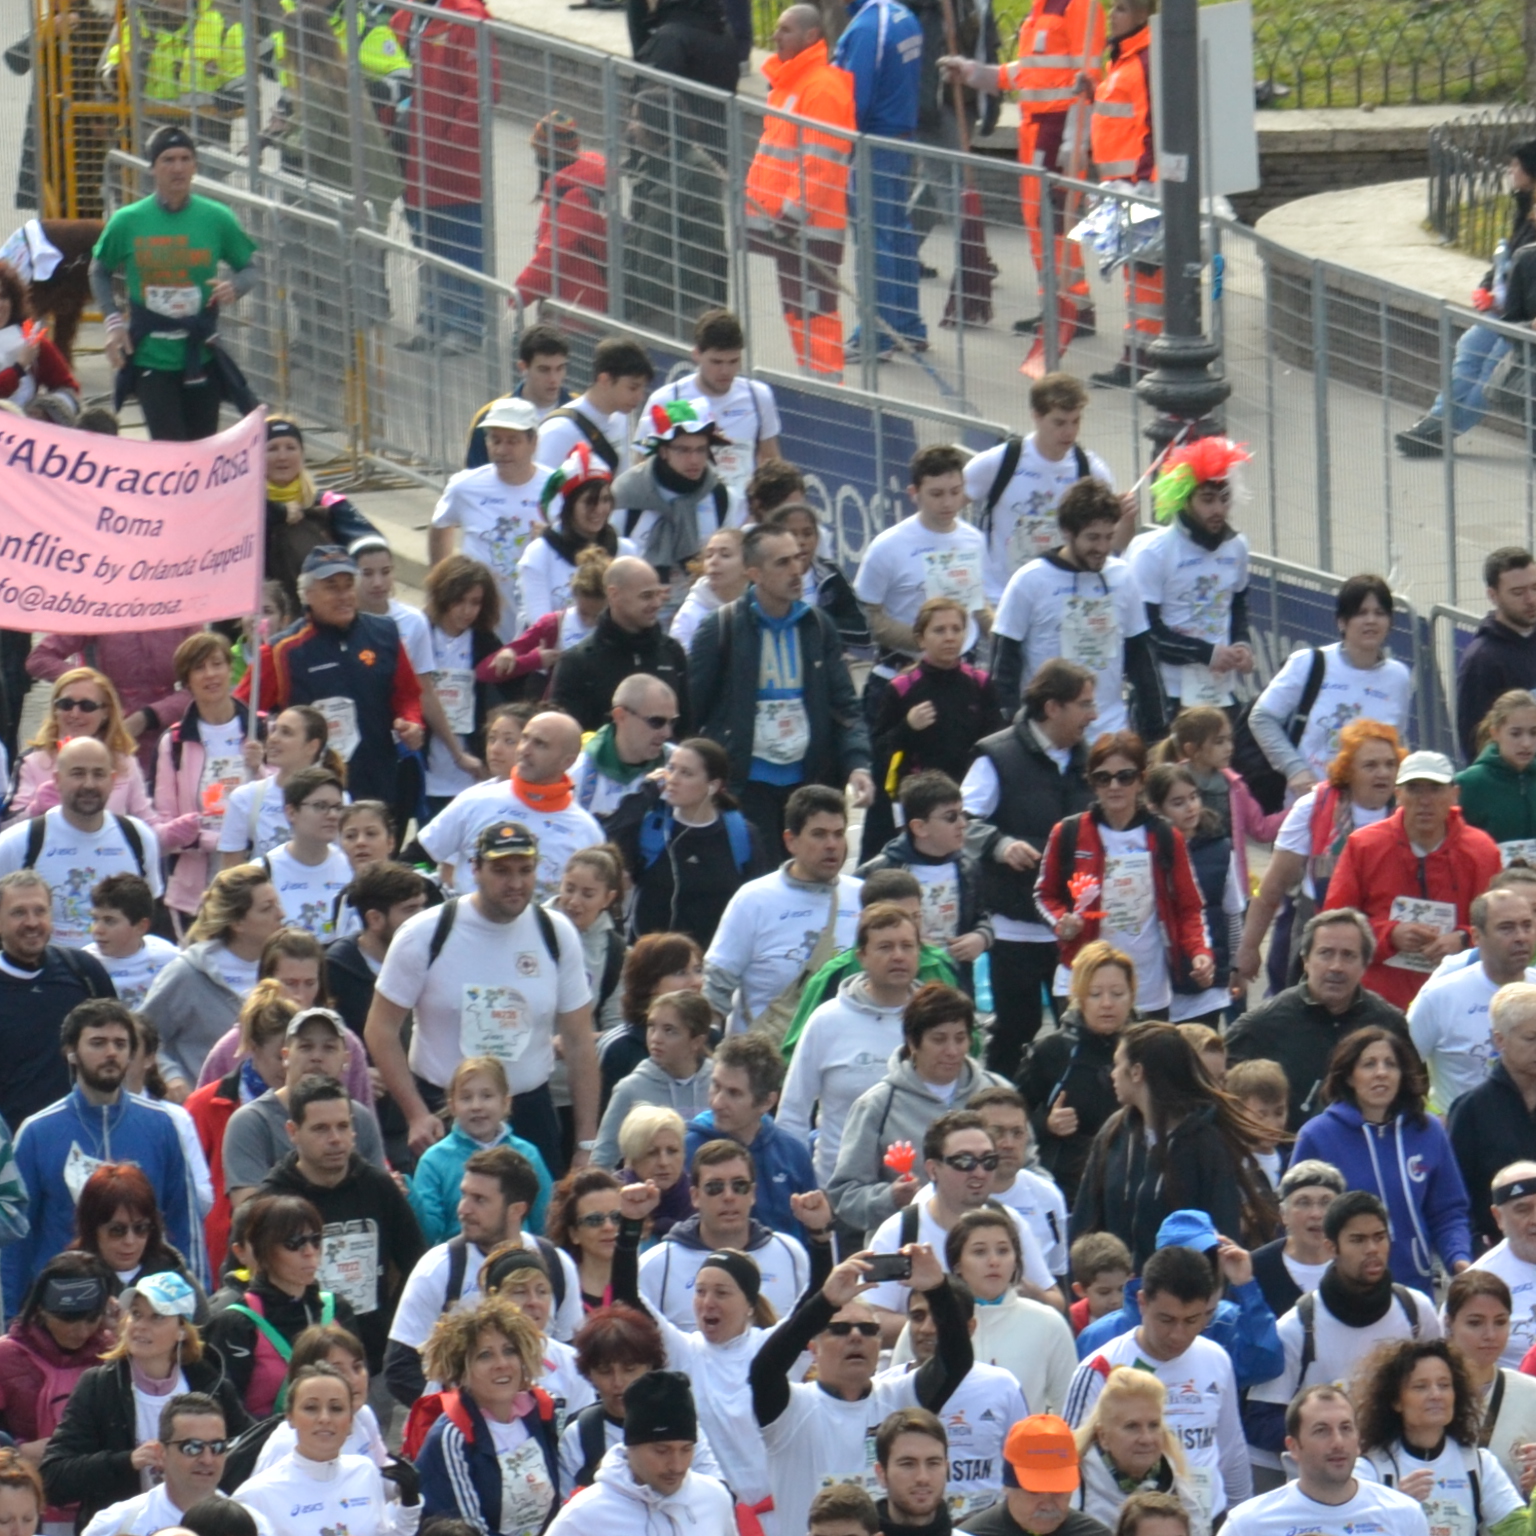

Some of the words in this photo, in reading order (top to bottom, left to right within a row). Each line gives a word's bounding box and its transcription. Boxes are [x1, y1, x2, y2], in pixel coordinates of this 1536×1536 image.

[96, 506, 164, 538] Roma
[94, 555, 125, 585] by
[129, 555, 197, 581] Orlanda
